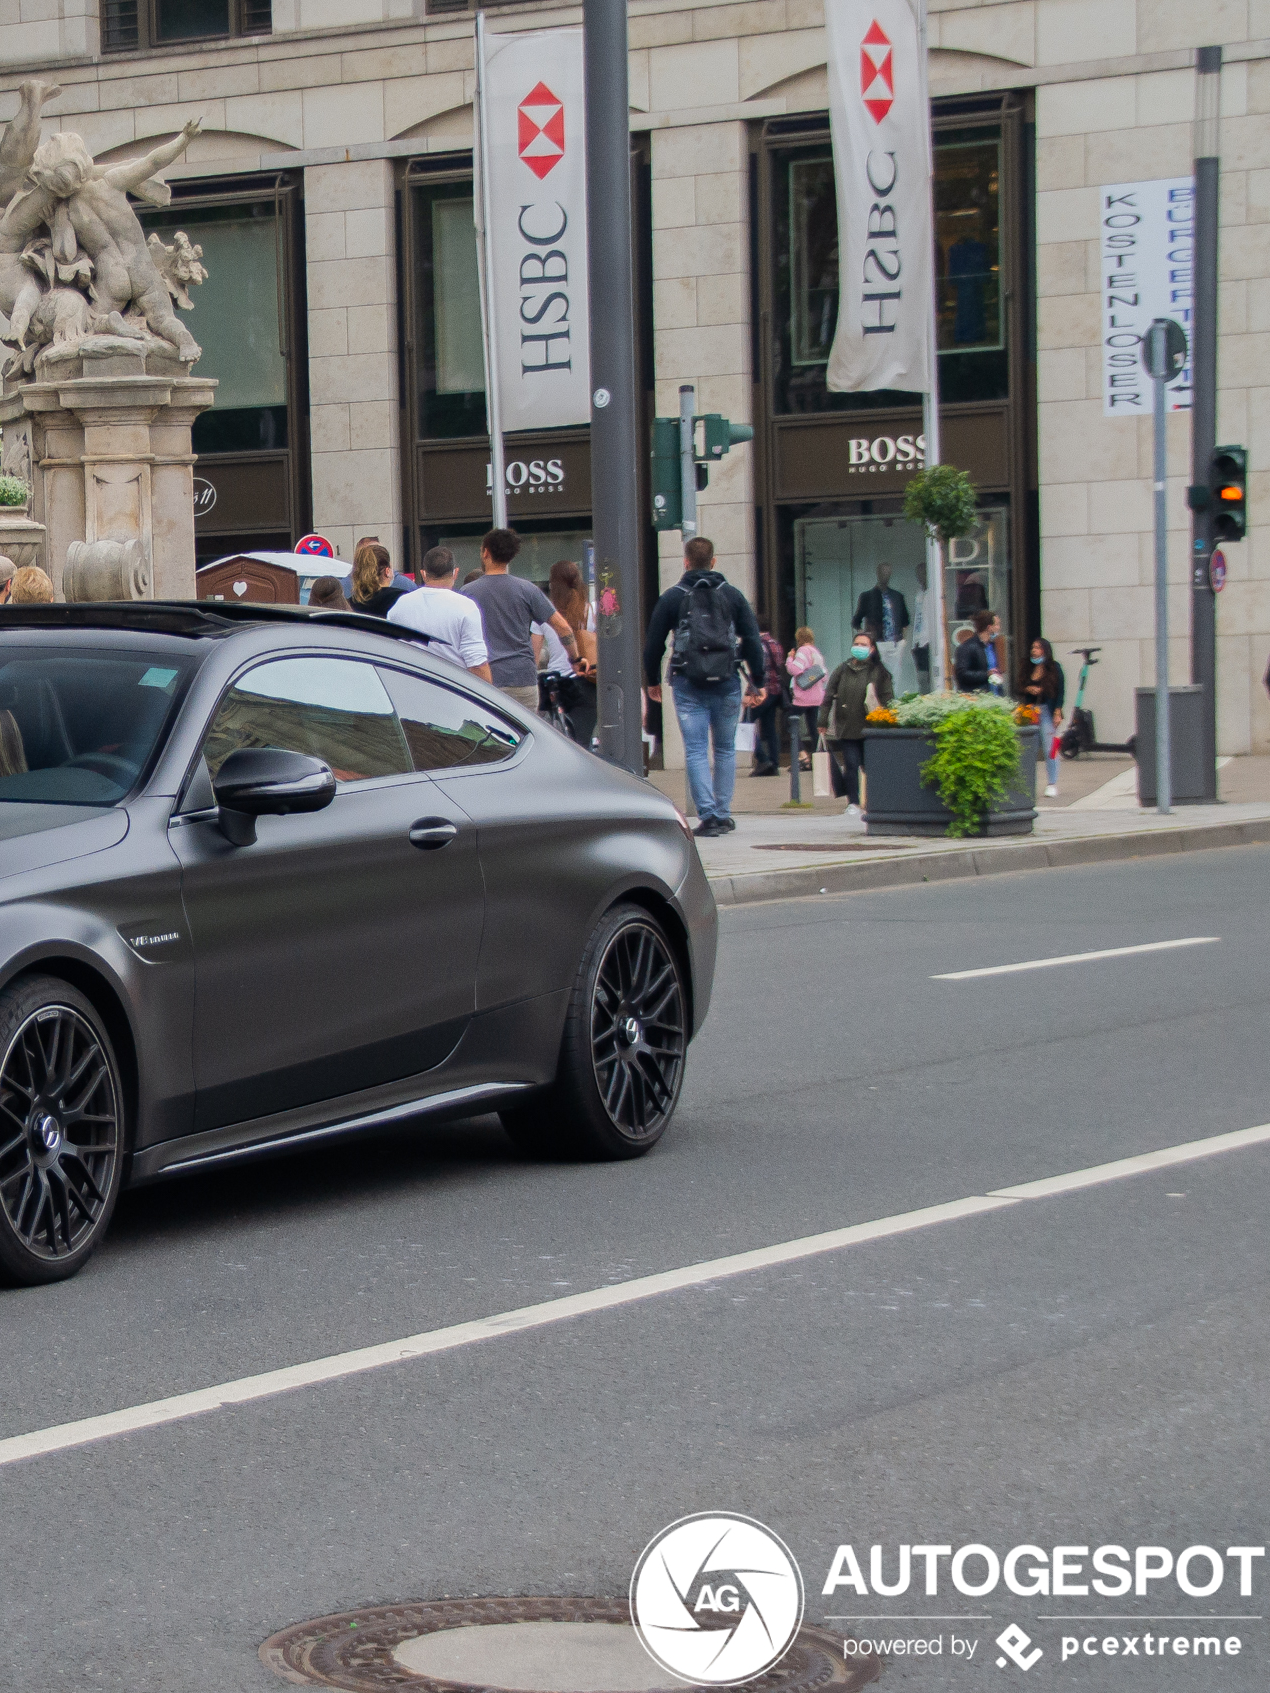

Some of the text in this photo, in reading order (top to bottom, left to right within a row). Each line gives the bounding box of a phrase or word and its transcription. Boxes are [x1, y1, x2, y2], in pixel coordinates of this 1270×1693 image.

[518, 201, 571, 379] HSBC
[1103, 192, 1142, 407] KOSTENLOSER
[486, 485, 564, 496] HGO BOSS
[848, 462, 925, 474] HUGO BOS
